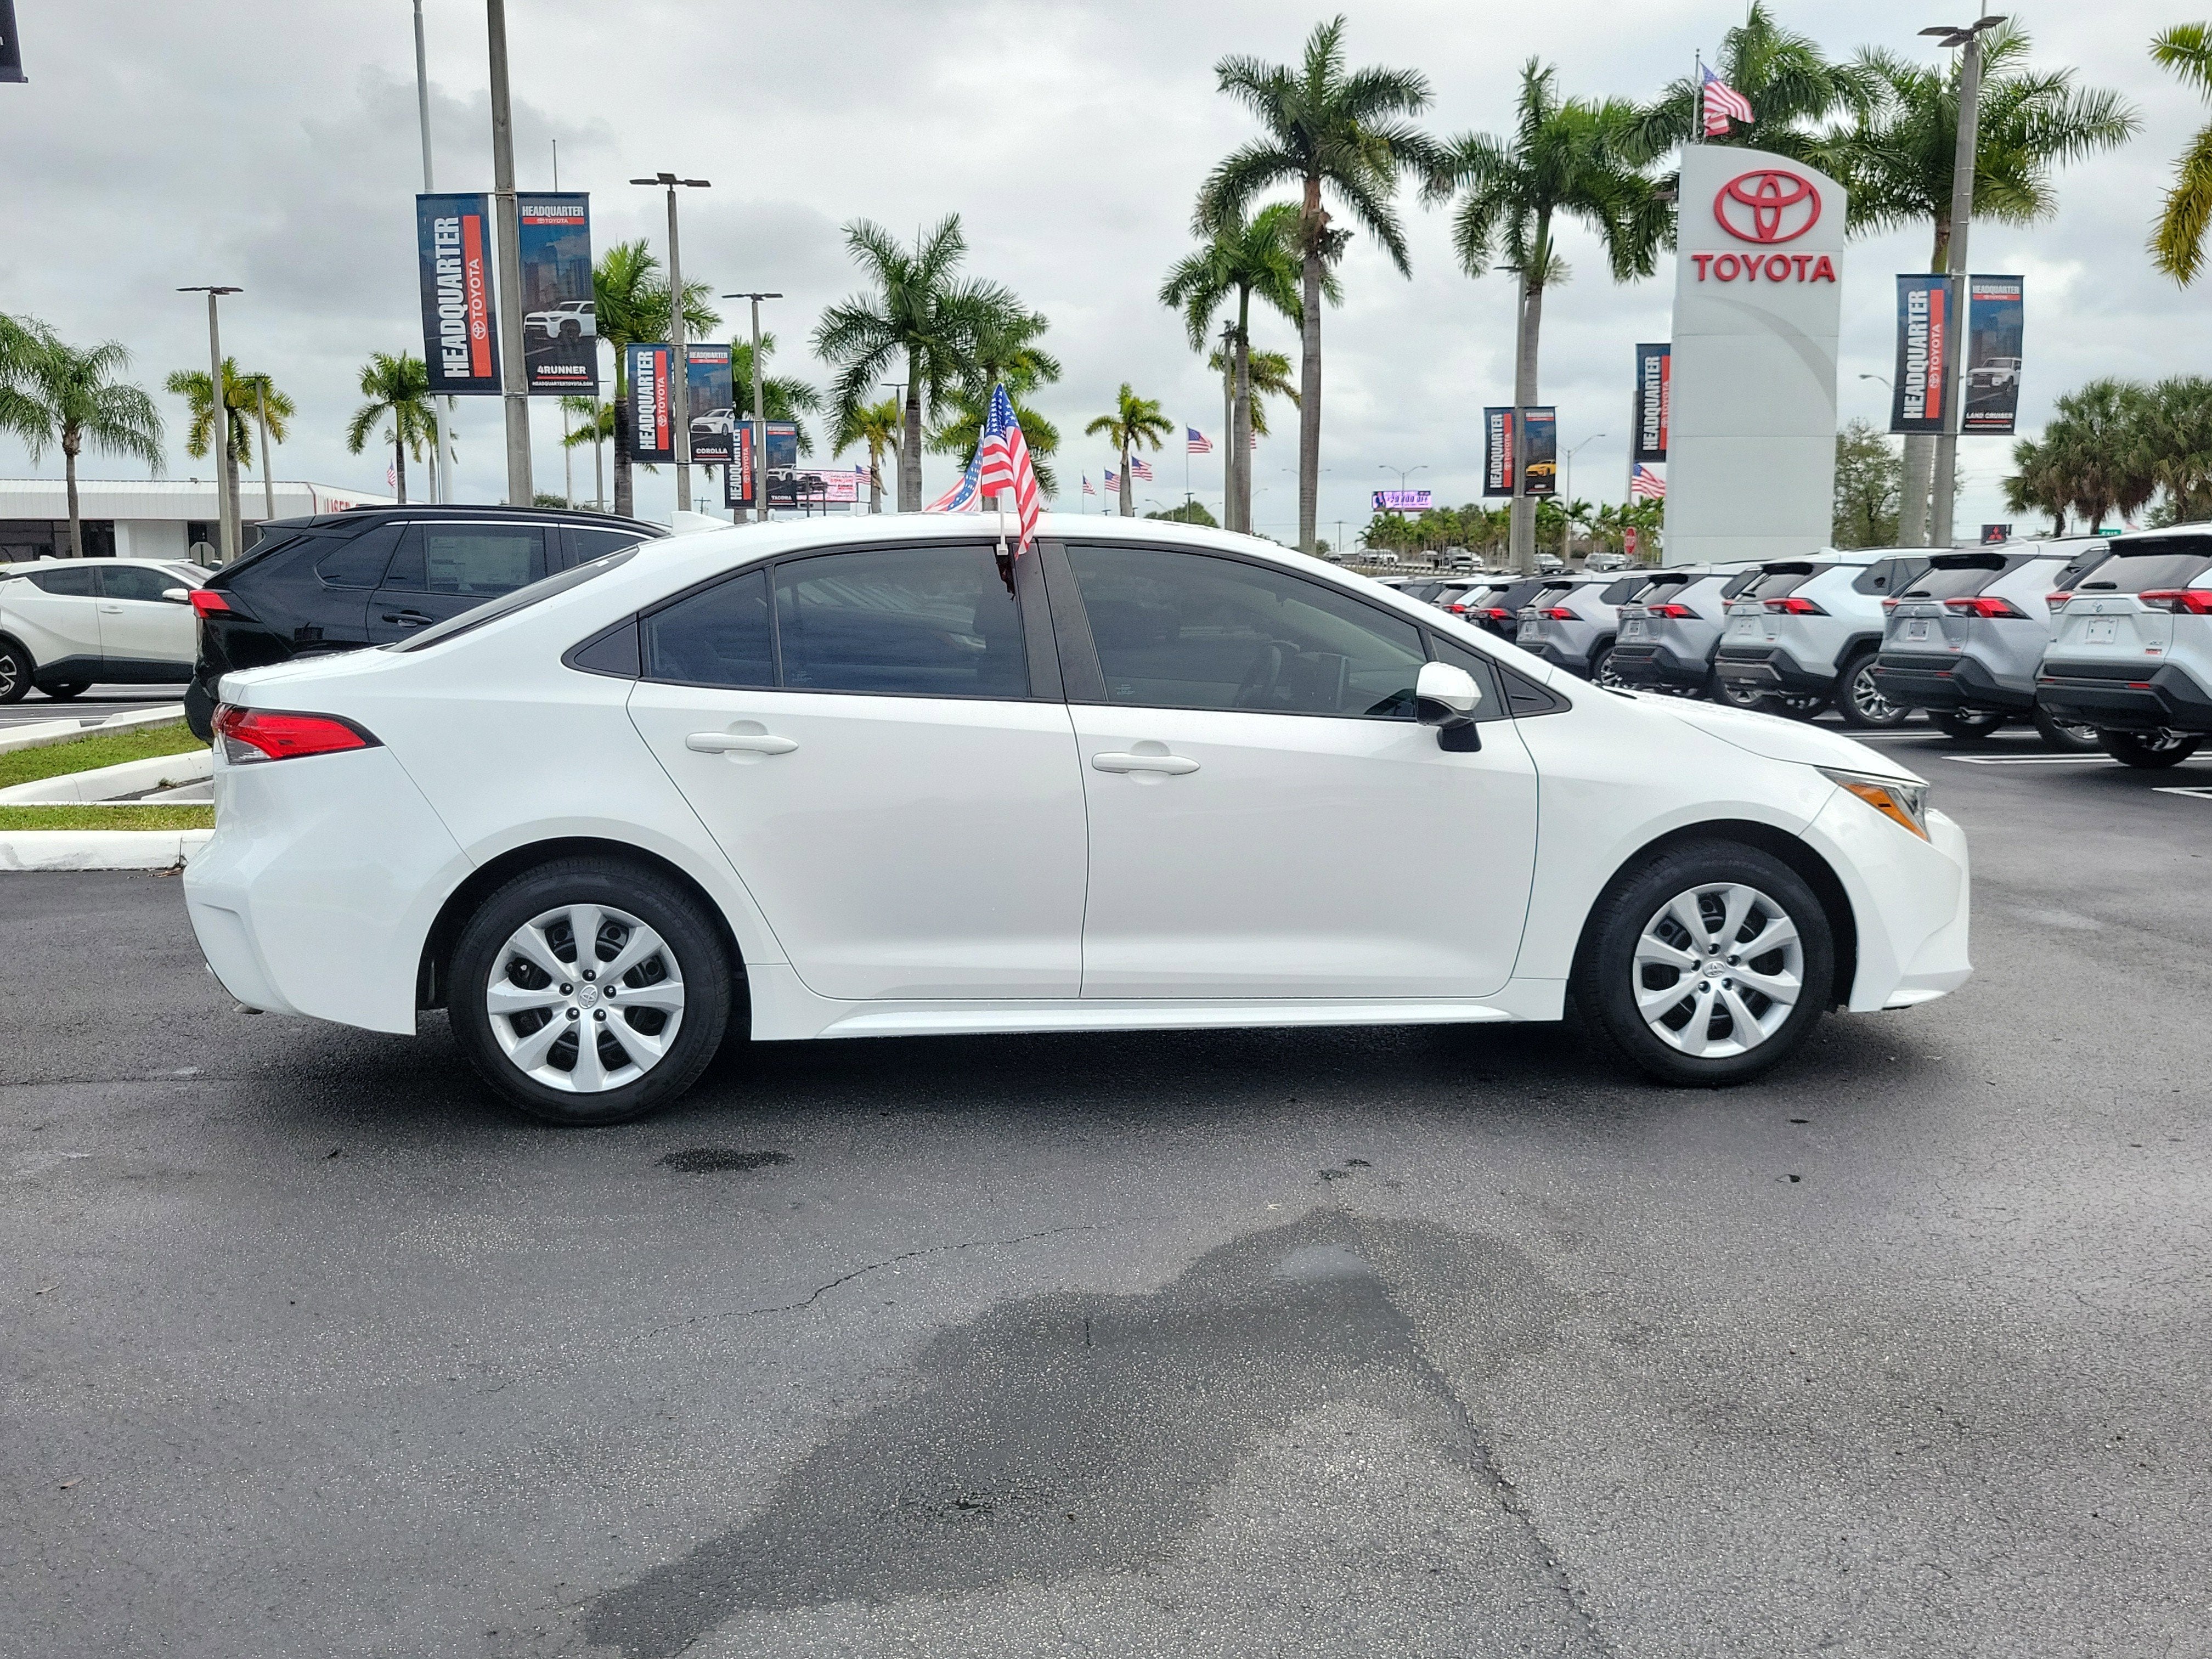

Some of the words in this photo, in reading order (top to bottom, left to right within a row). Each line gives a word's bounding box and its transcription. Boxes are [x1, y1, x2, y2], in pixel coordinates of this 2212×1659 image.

[522, 206, 584, 217] HEADQUARTER
[434, 217, 470, 377] HEADQUARTER
[469, 258, 483, 319] TOYOTA
[1691, 254, 1836, 282] TOYOTA
[537, 365, 586, 374] 4RUNNER
[1903, 290, 1928, 419] HEADQUARTER
[1930, 324, 1942, 371] TOYOTA
[637, 351, 656, 450] HEADQUARTER
[658, 377, 666, 414] TOYOTA
[1643, 356, 1661, 450] HEADQUARTER
[1490, 415, 1504, 488] HEADQUARTER
